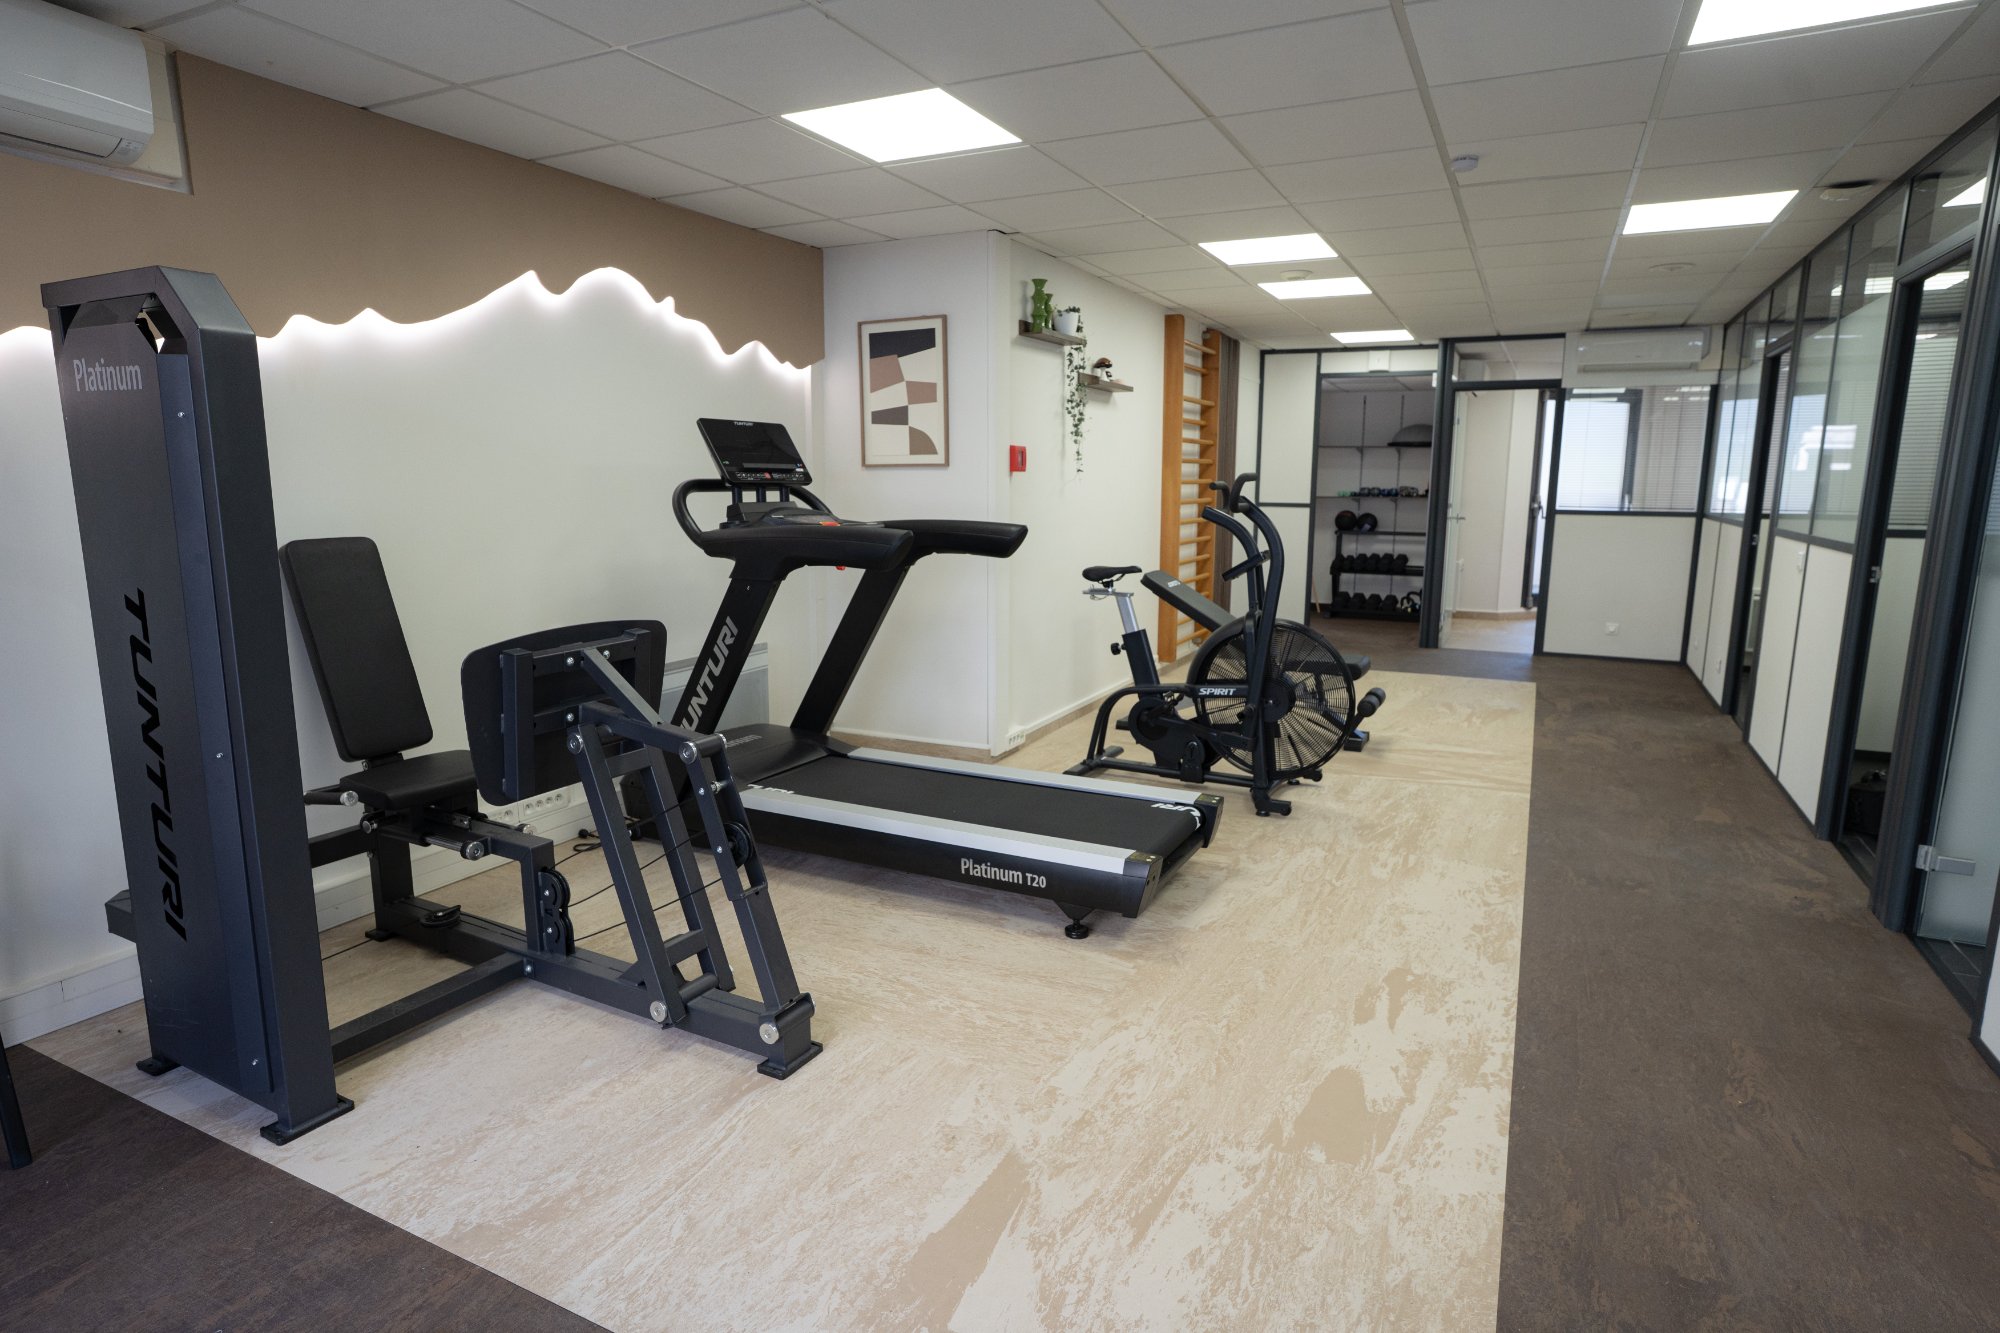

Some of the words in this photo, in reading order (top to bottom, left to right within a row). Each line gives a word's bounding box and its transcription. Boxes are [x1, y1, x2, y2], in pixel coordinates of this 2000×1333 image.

[73, 357, 143, 392] Platinum
[680, 615, 739, 732] UNTURI
[1198, 687, 1237, 696] SPIRIT
[123, 587, 188, 942] TUNTURI
[960, 857, 1023, 885] Platinum
[1025, 872, 1047, 889] T20
